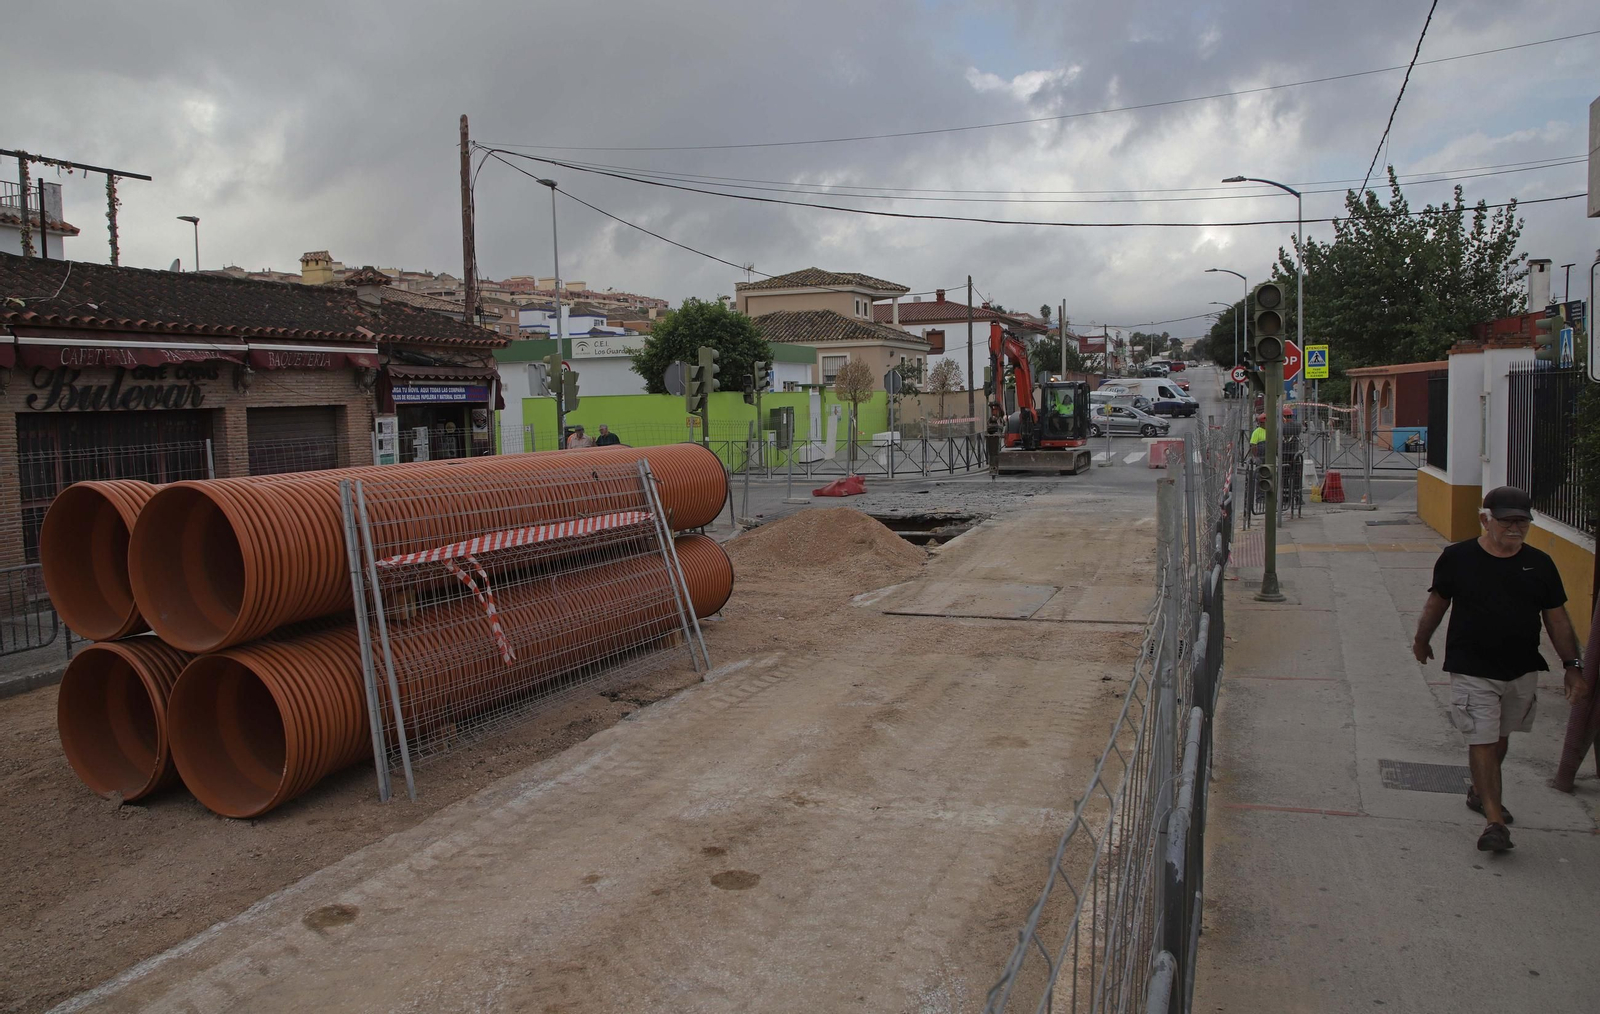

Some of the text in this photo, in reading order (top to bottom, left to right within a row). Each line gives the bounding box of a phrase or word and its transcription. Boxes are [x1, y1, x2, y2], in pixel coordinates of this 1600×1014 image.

[60, 348, 138, 364] CAFETERIA
[268, 352, 332, 366] BAQUETERIA
[1283, 356, 1298, 365] OP
[26, 365, 208, 410] Bulevar
